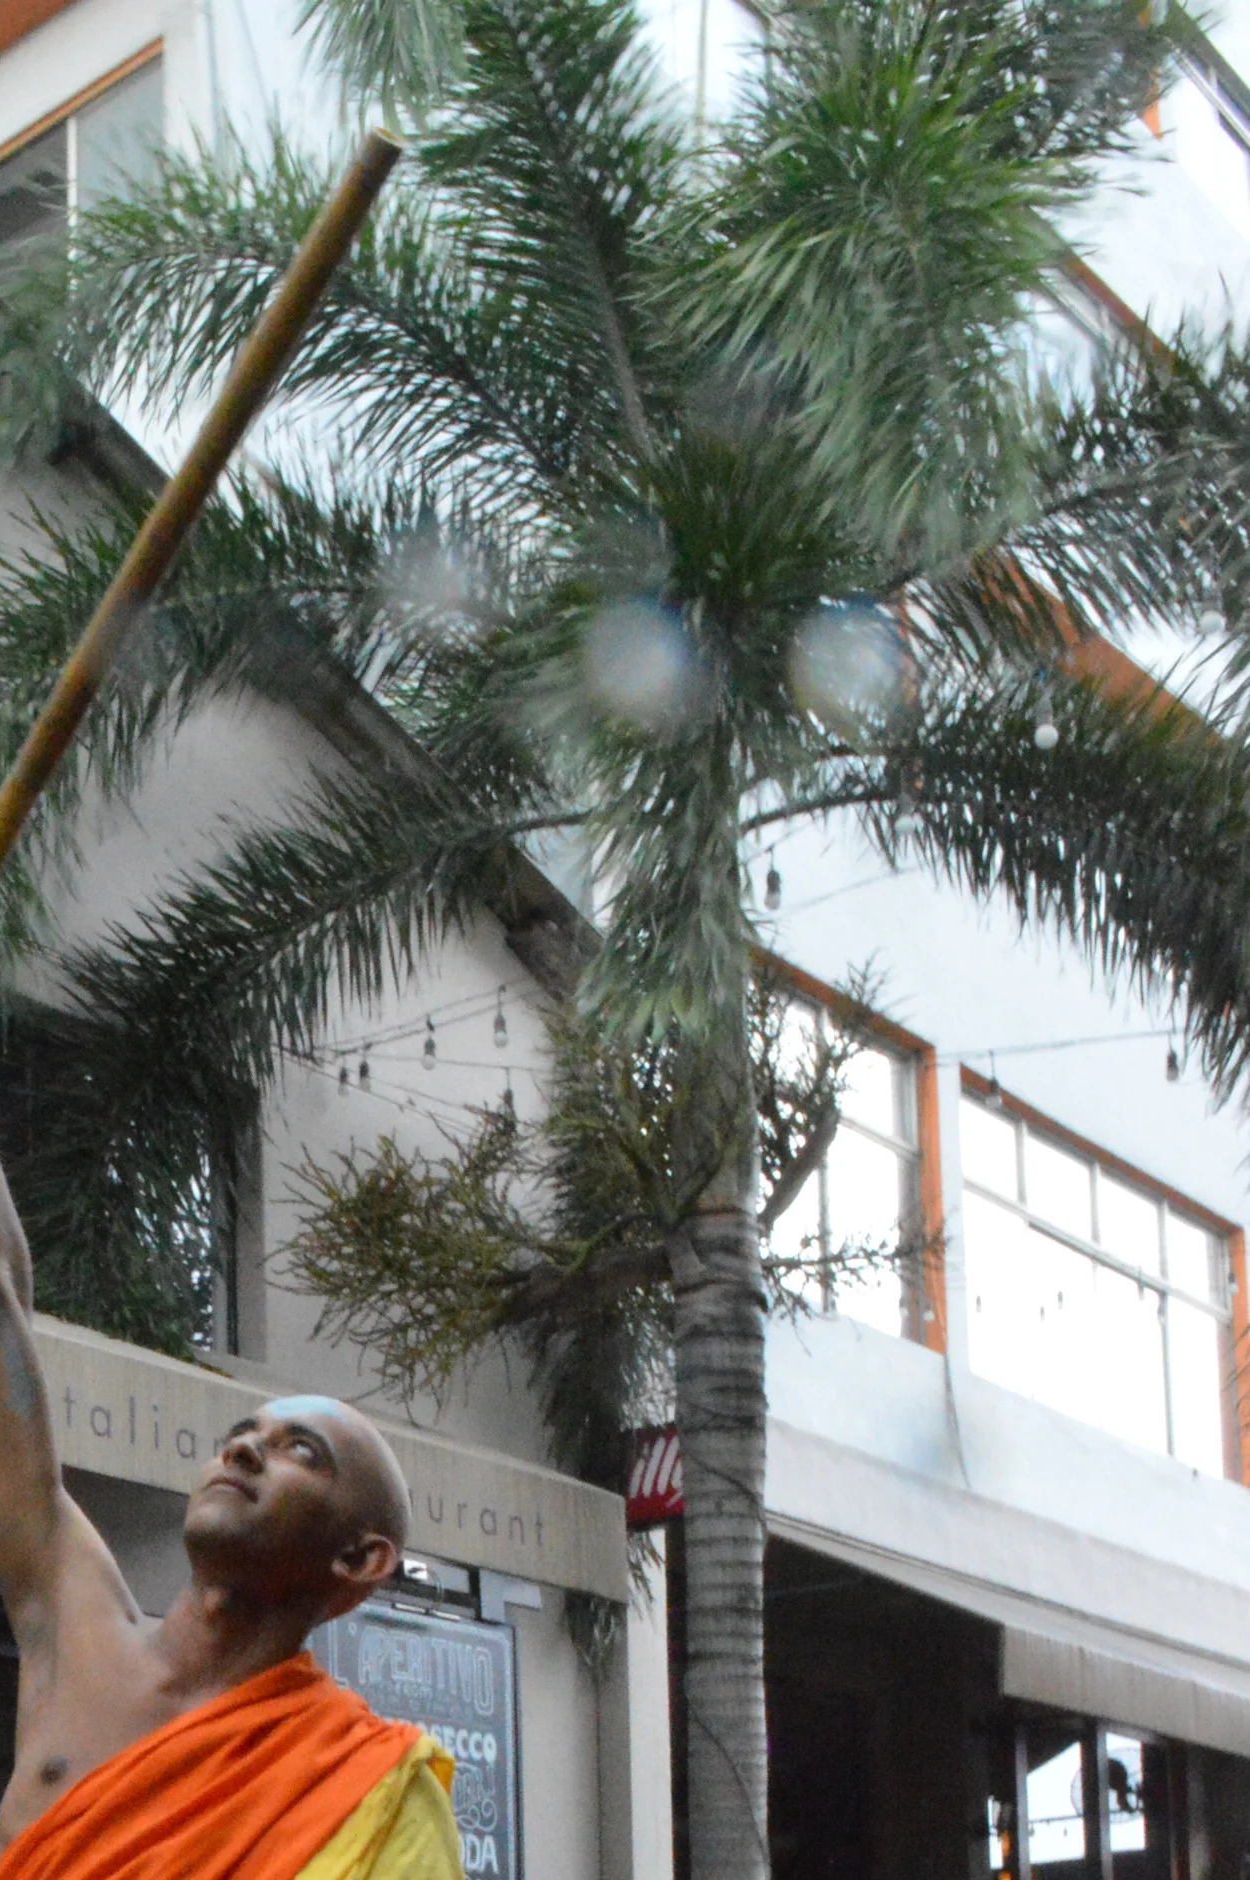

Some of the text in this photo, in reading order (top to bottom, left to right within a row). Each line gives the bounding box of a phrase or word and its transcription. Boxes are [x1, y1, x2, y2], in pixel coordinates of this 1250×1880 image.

[63, 1386, 543, 1549] talia urant
[456, 1833, 500, 1874] DA
